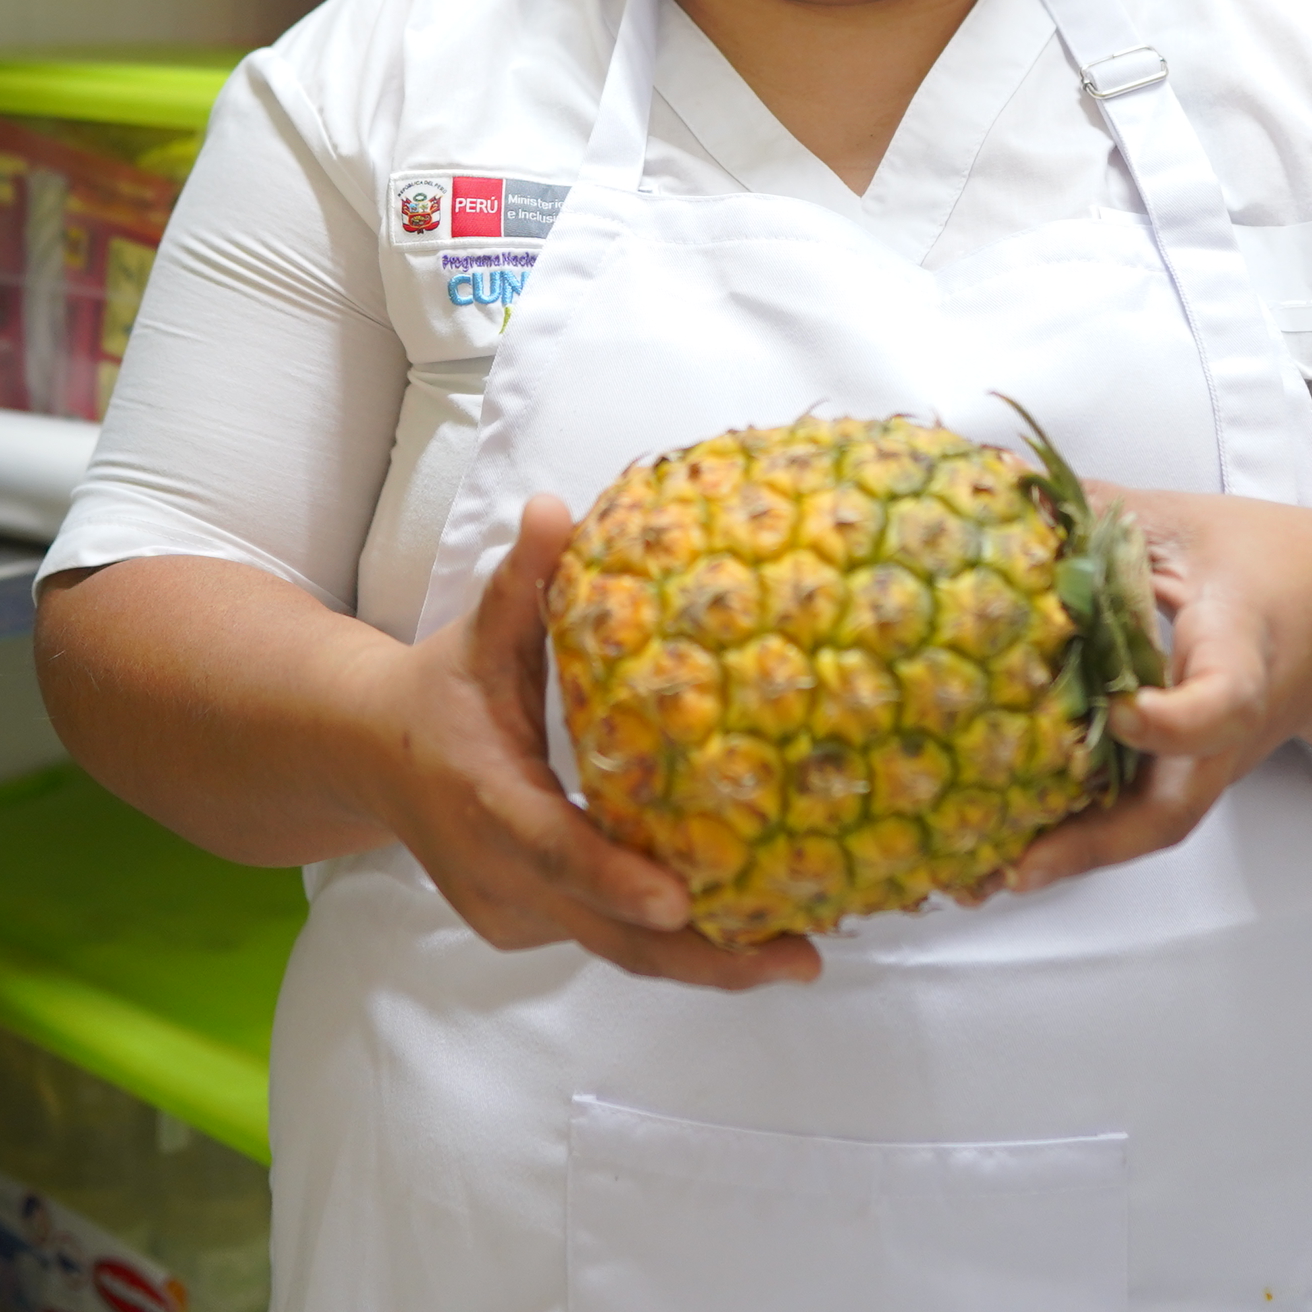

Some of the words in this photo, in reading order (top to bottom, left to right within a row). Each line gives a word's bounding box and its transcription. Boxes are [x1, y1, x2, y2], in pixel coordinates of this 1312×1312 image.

[455, 197, 498, 214] PERÚ
[507, 210, 516, 219] e
[442, 254, 501, 272] Programa
